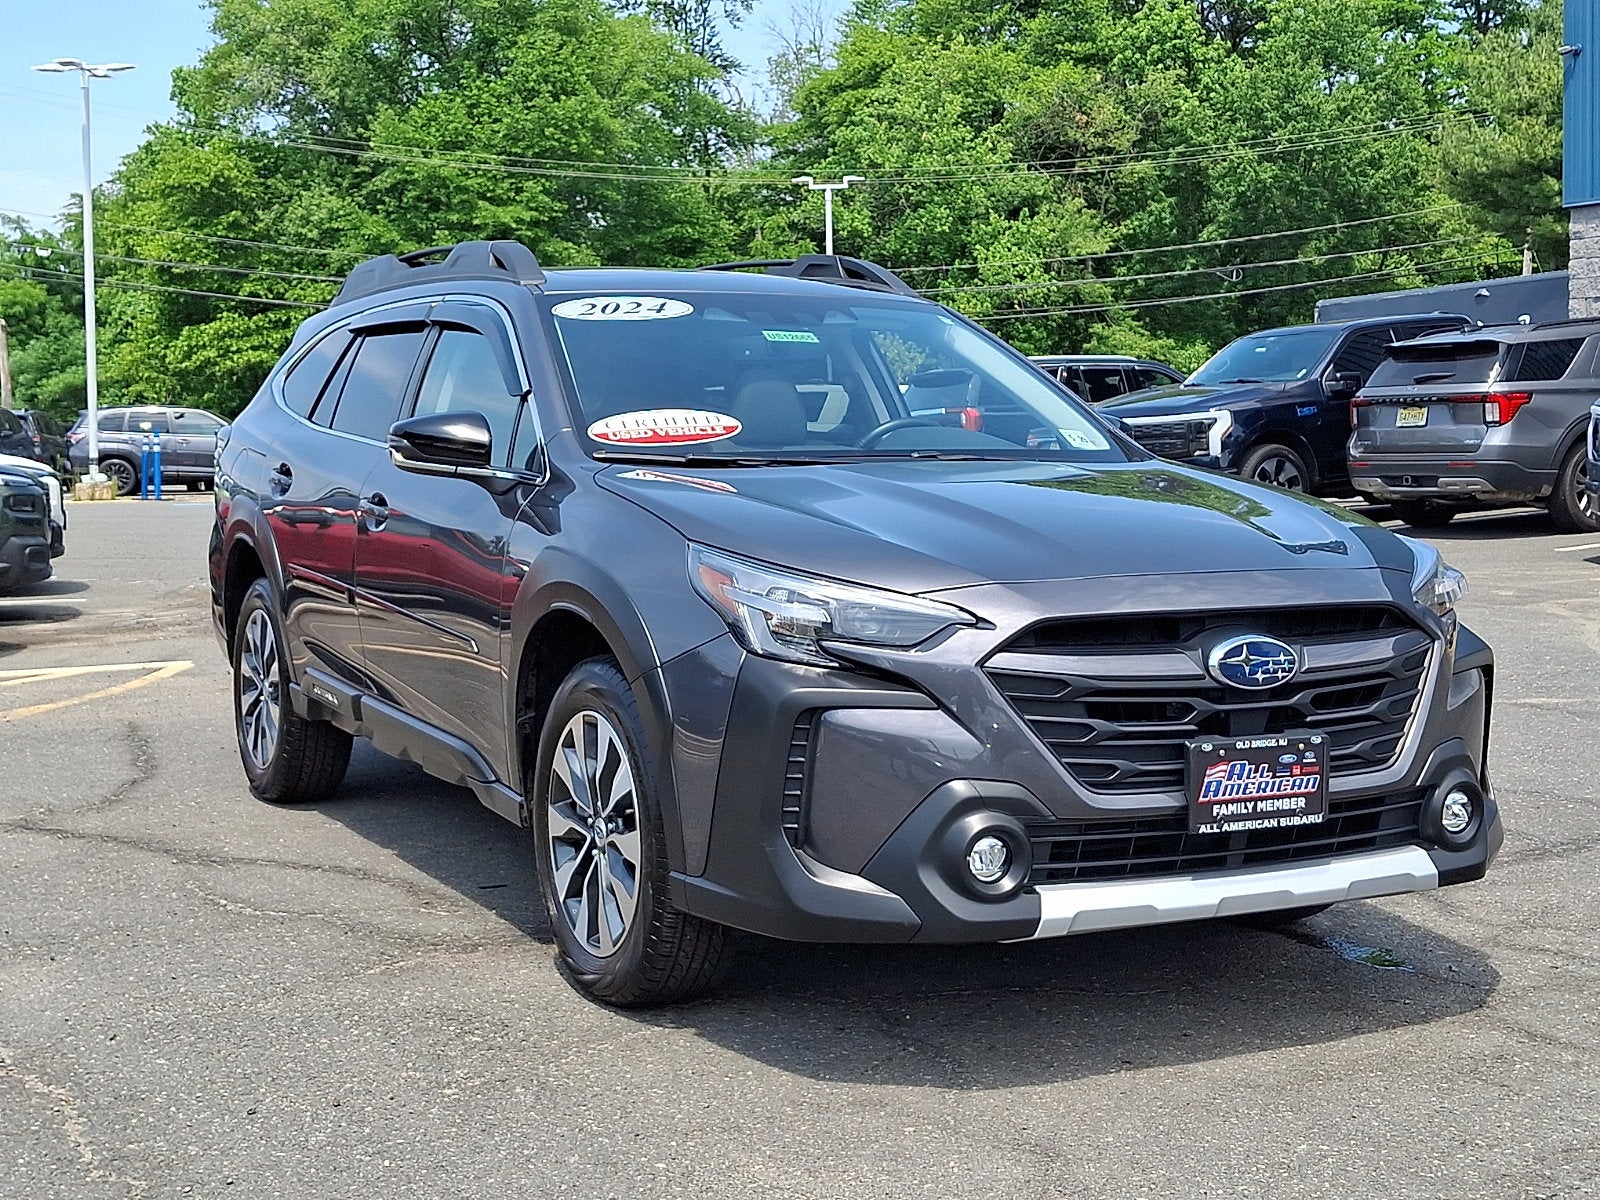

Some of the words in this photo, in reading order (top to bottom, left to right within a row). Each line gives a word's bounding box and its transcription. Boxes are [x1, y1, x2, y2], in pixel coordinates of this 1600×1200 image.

[577, 301, 668, 316] 2024
[608, 428, 653, 441] USED
[653, 425, 726, 437] VEHICLE
[1236, 740, 1249, 749] OLD
[1279, 738, 1288, 746] NJ
[1226, 761, 1273, 781] ALL
[1201, 775, 1320, 800] AMERICAN
[1212, 801, 1255, 817] FAMILY
[1256, 797, 1306, 812] MEMBER
[1199, 823, 1221, 833] ALL
[1222, 818, 1278, 832] AMERICAN
[1279, 814, 1323, 827] SUBARU
